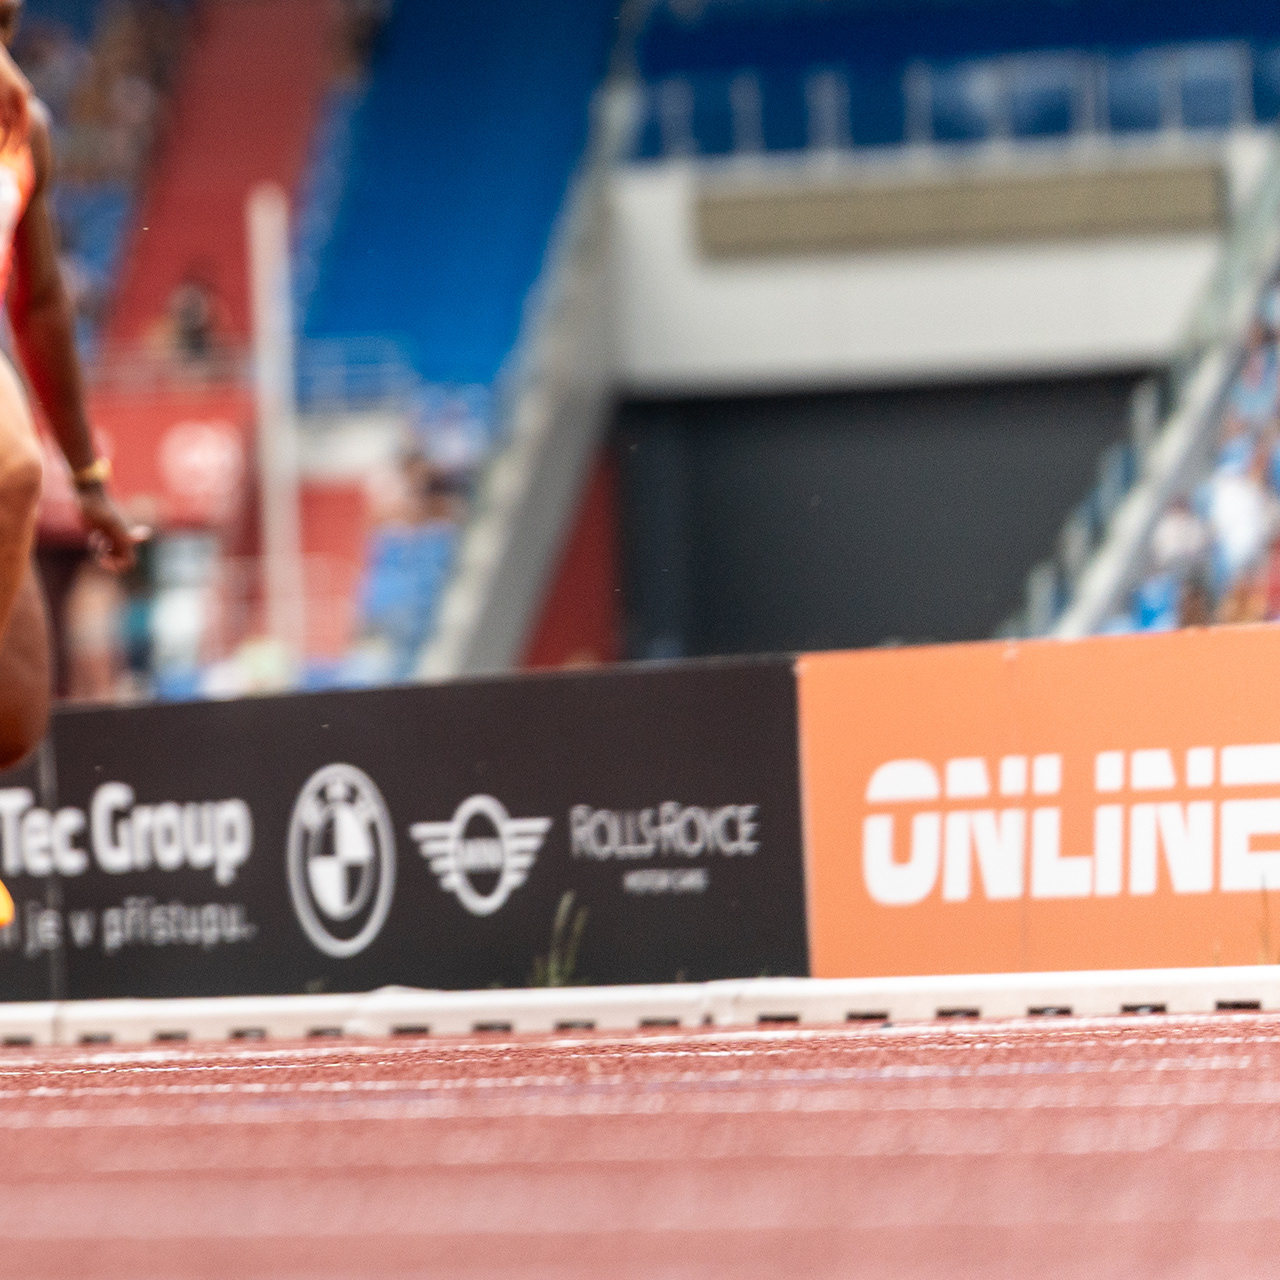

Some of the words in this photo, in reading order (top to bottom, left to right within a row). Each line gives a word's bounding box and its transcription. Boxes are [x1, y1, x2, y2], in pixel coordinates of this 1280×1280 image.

[89, 781, 254, 886] Group
[863, 742, 1280, 907] ONLINE
[23, 900, 62, 958] je
[69, 909, 96, 949] v
